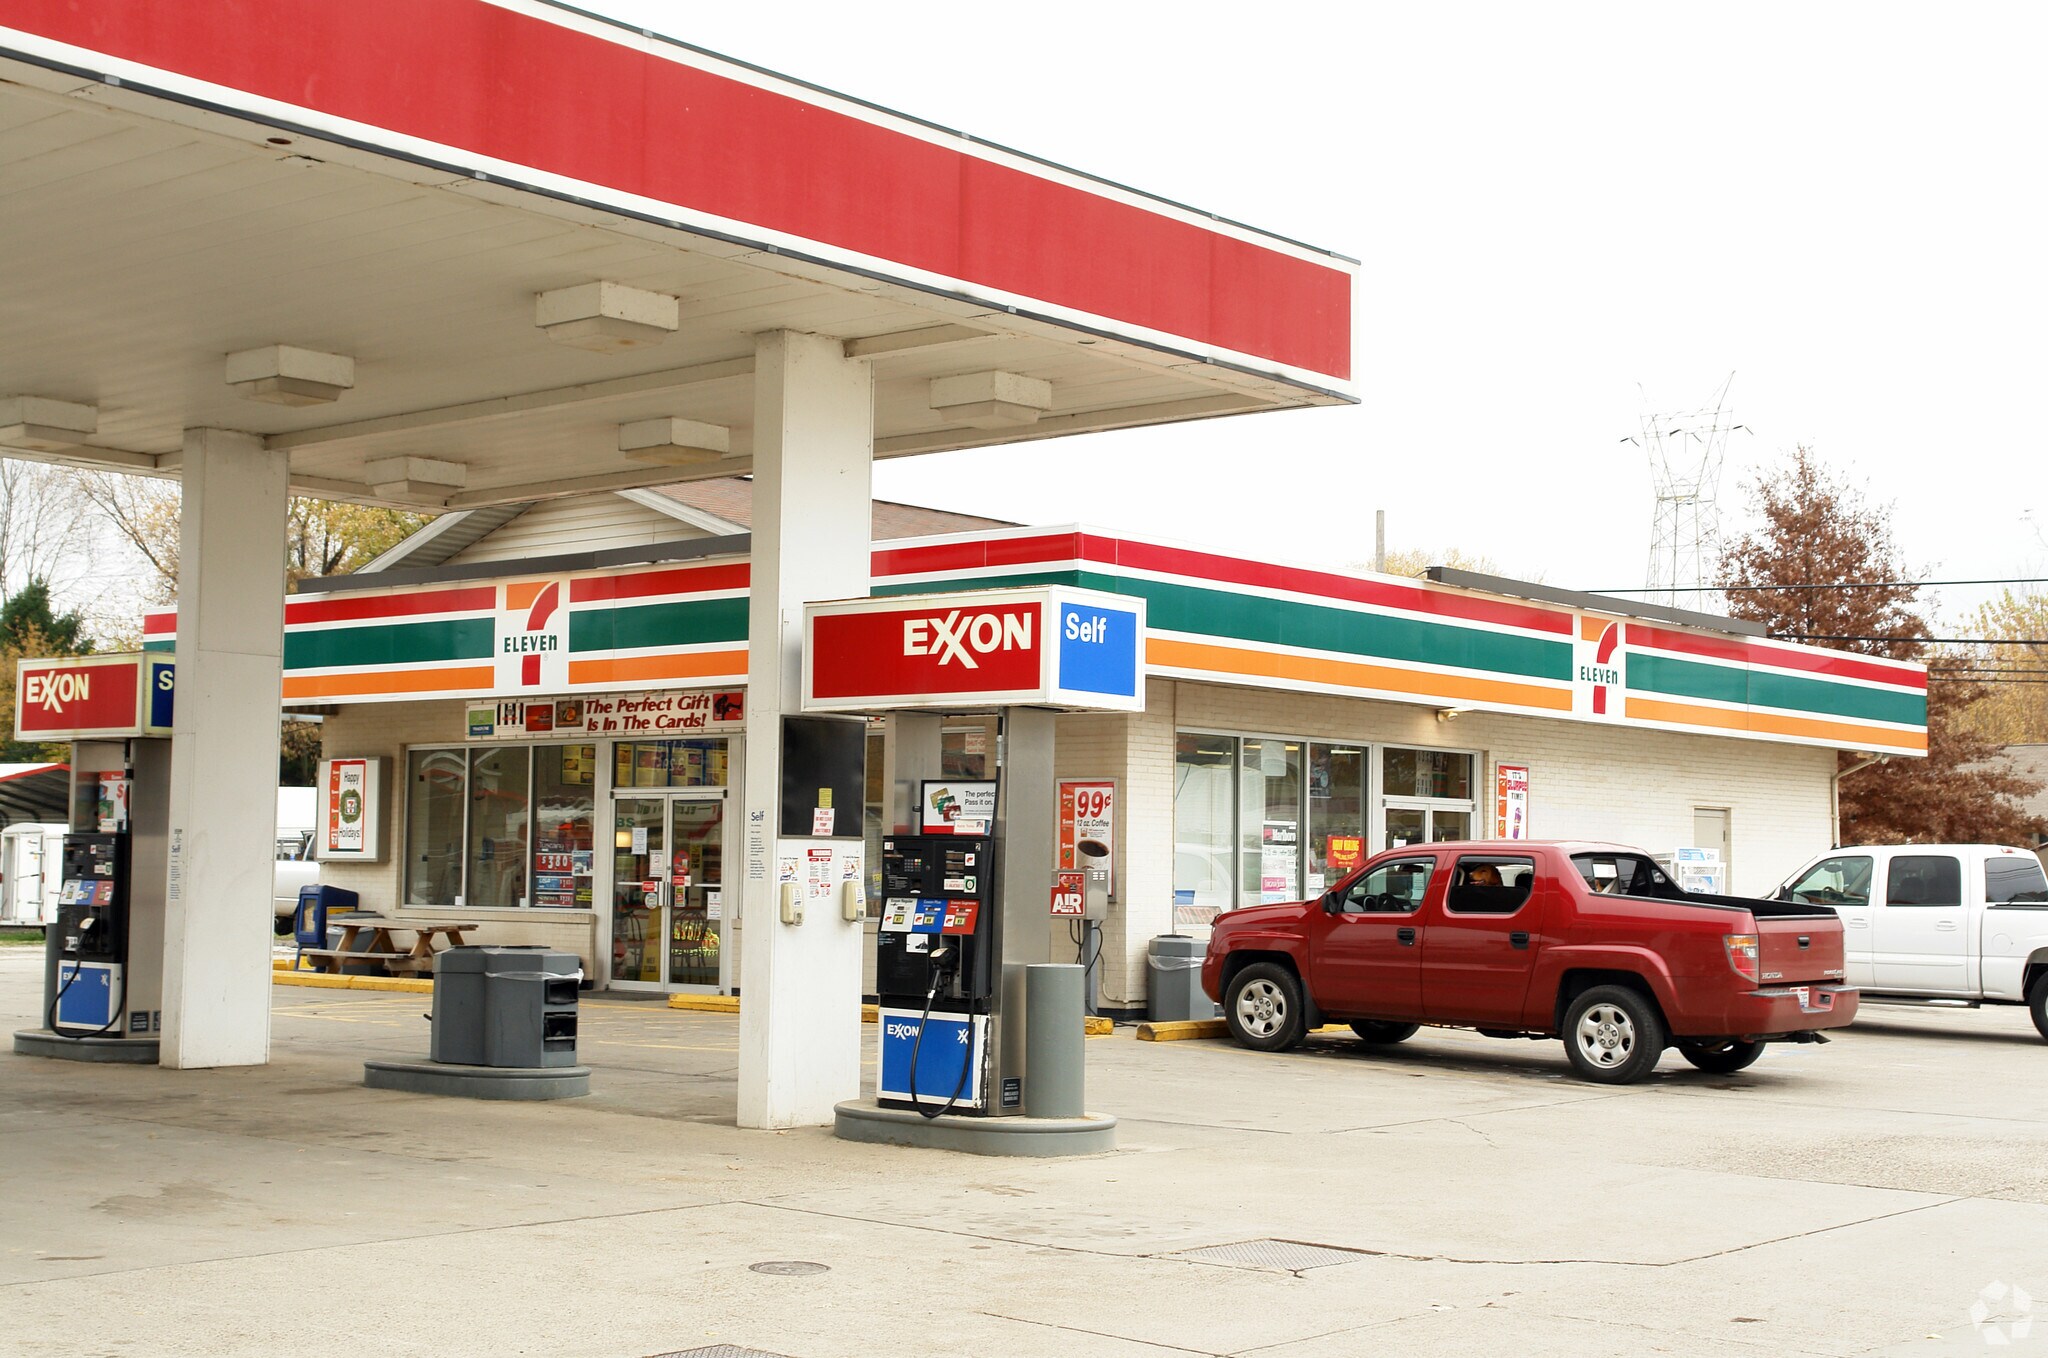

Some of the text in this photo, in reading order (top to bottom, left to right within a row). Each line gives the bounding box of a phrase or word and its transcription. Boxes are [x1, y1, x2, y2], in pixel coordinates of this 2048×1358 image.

[1065, 612, 1107, 644] Self
[903, 610, 1032, 669] EXXON
[26, 670, 90, 713] EXXON
[586, 694, 710, 714] The Perfect Gift
[587, 712, 707, 731] Is In The Cards!
[344, 772, 360, 785] Happy
[751, 811, 764, 821] Self
[1091, 819, 1109, 827] Coffee
[1052, 894, 1082, 914] AIR
[887, 1023, 919, 1040] EXXON
